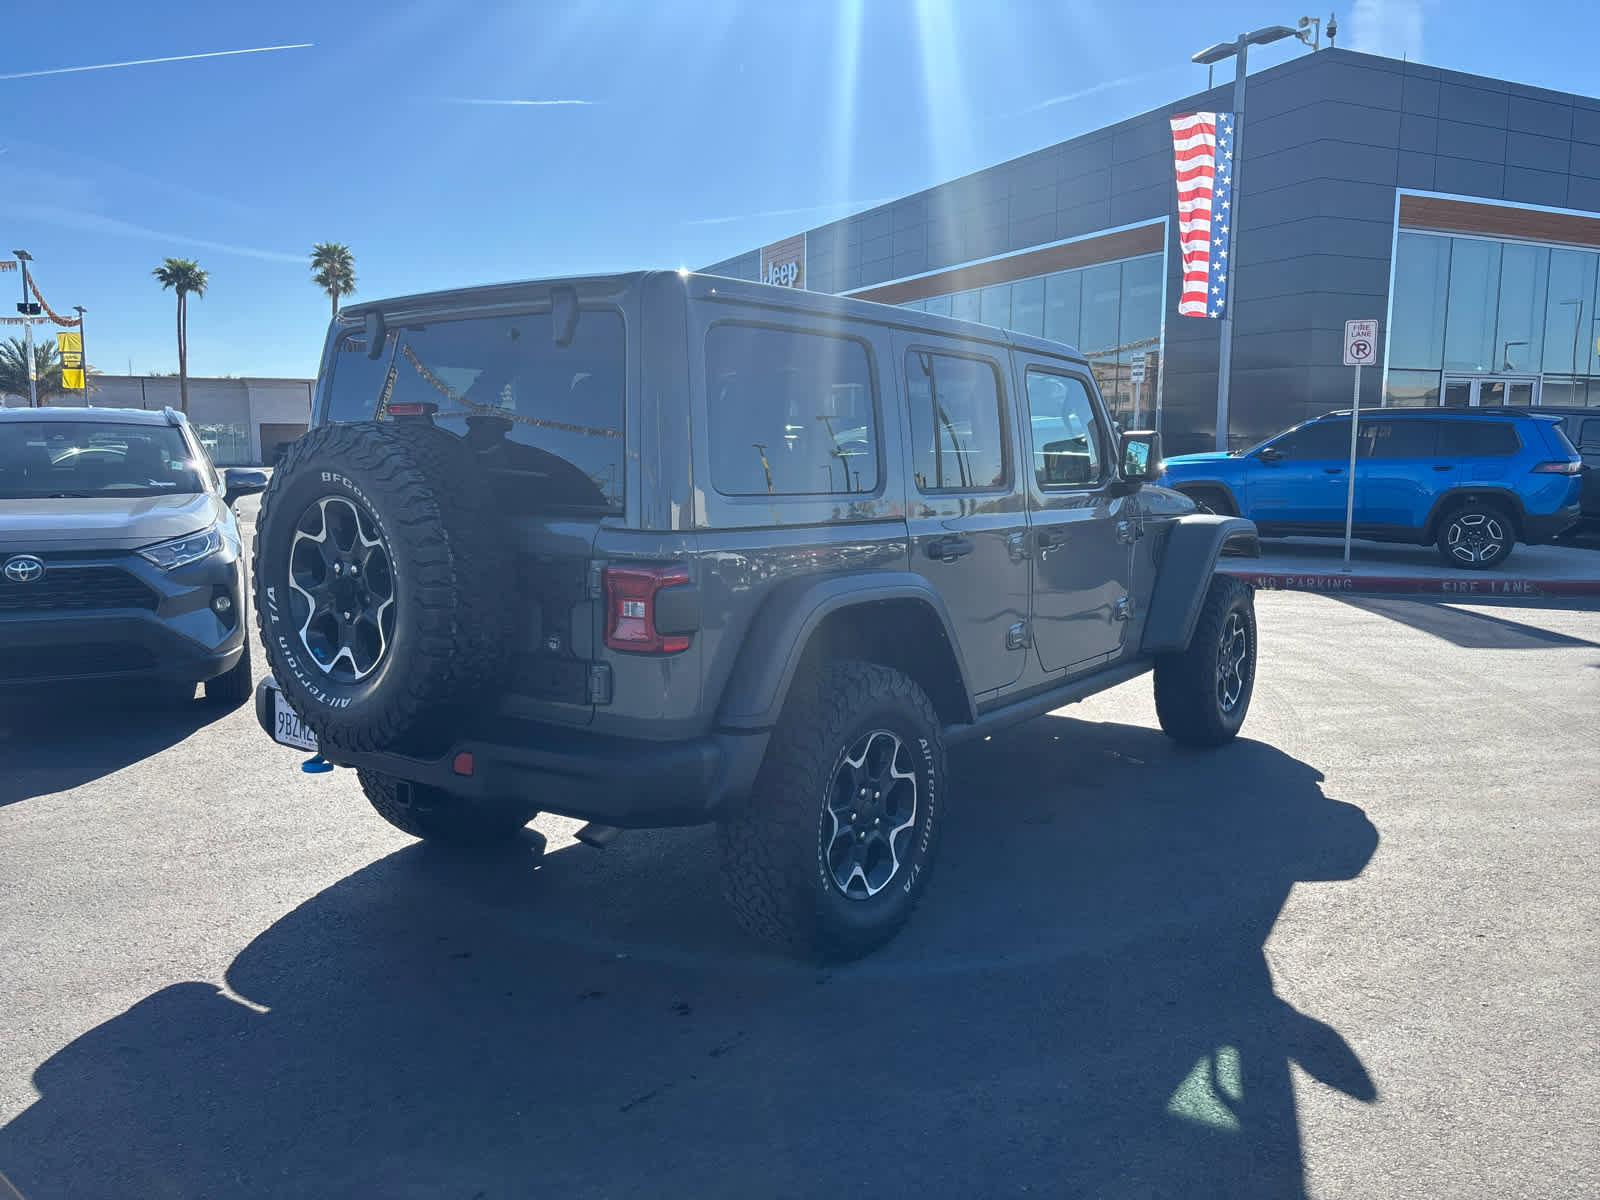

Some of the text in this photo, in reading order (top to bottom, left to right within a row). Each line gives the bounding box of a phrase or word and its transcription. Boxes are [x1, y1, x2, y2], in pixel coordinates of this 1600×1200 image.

[763, 261, 798, 288] Jeep
[1257, 576, 1352, 589] NO PARKING
[1442, 582, 1532, 592] FIRE LANE
[265, 586, 281, 623] T/A
[279, 636, 352, 708] All-Terrain
[903, 738, 936, 893] All-Terrain T/A
